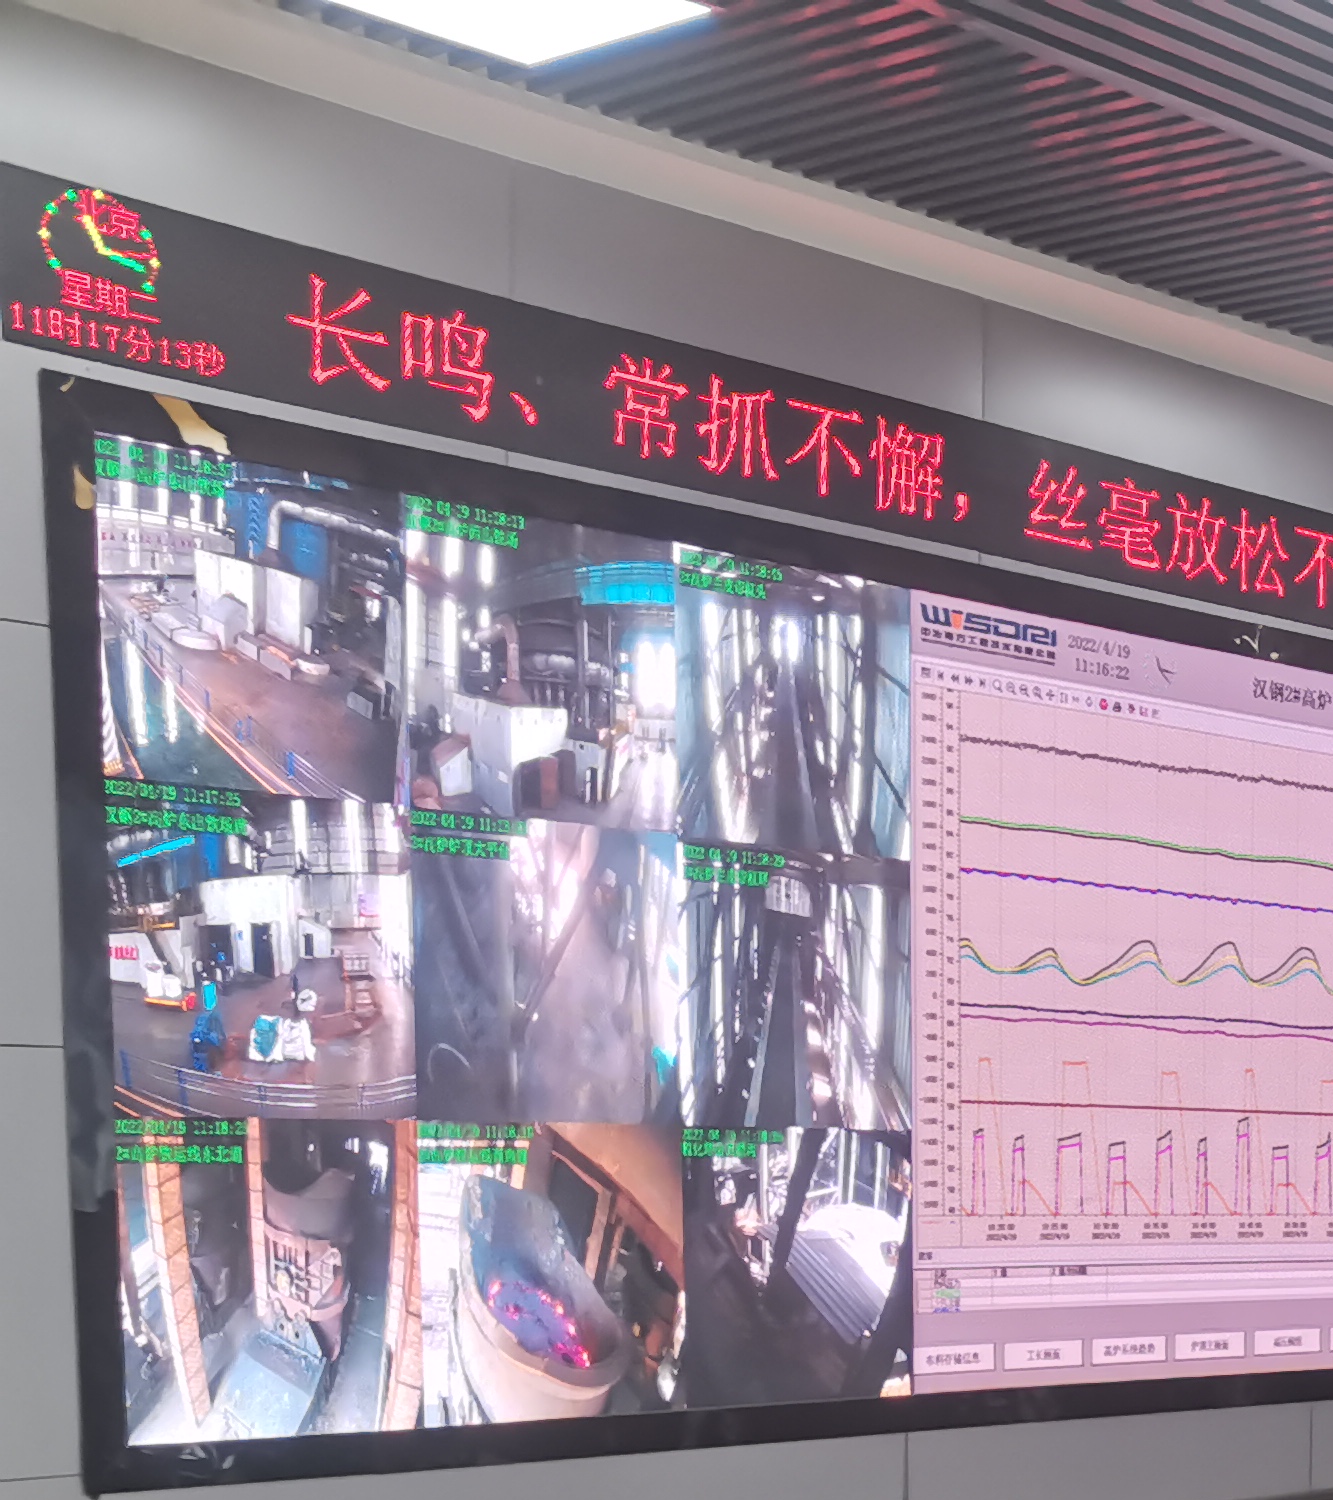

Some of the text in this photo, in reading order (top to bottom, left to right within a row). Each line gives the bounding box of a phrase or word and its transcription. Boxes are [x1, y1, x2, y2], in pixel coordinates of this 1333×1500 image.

[61, 269, 162, 324] 星期二
[10, 301, 227, 377] 11时17分13秒
[1068, 633, 1131, 660] 2022/4/19
[1075, 657, 1131, 681] 11:16:22
